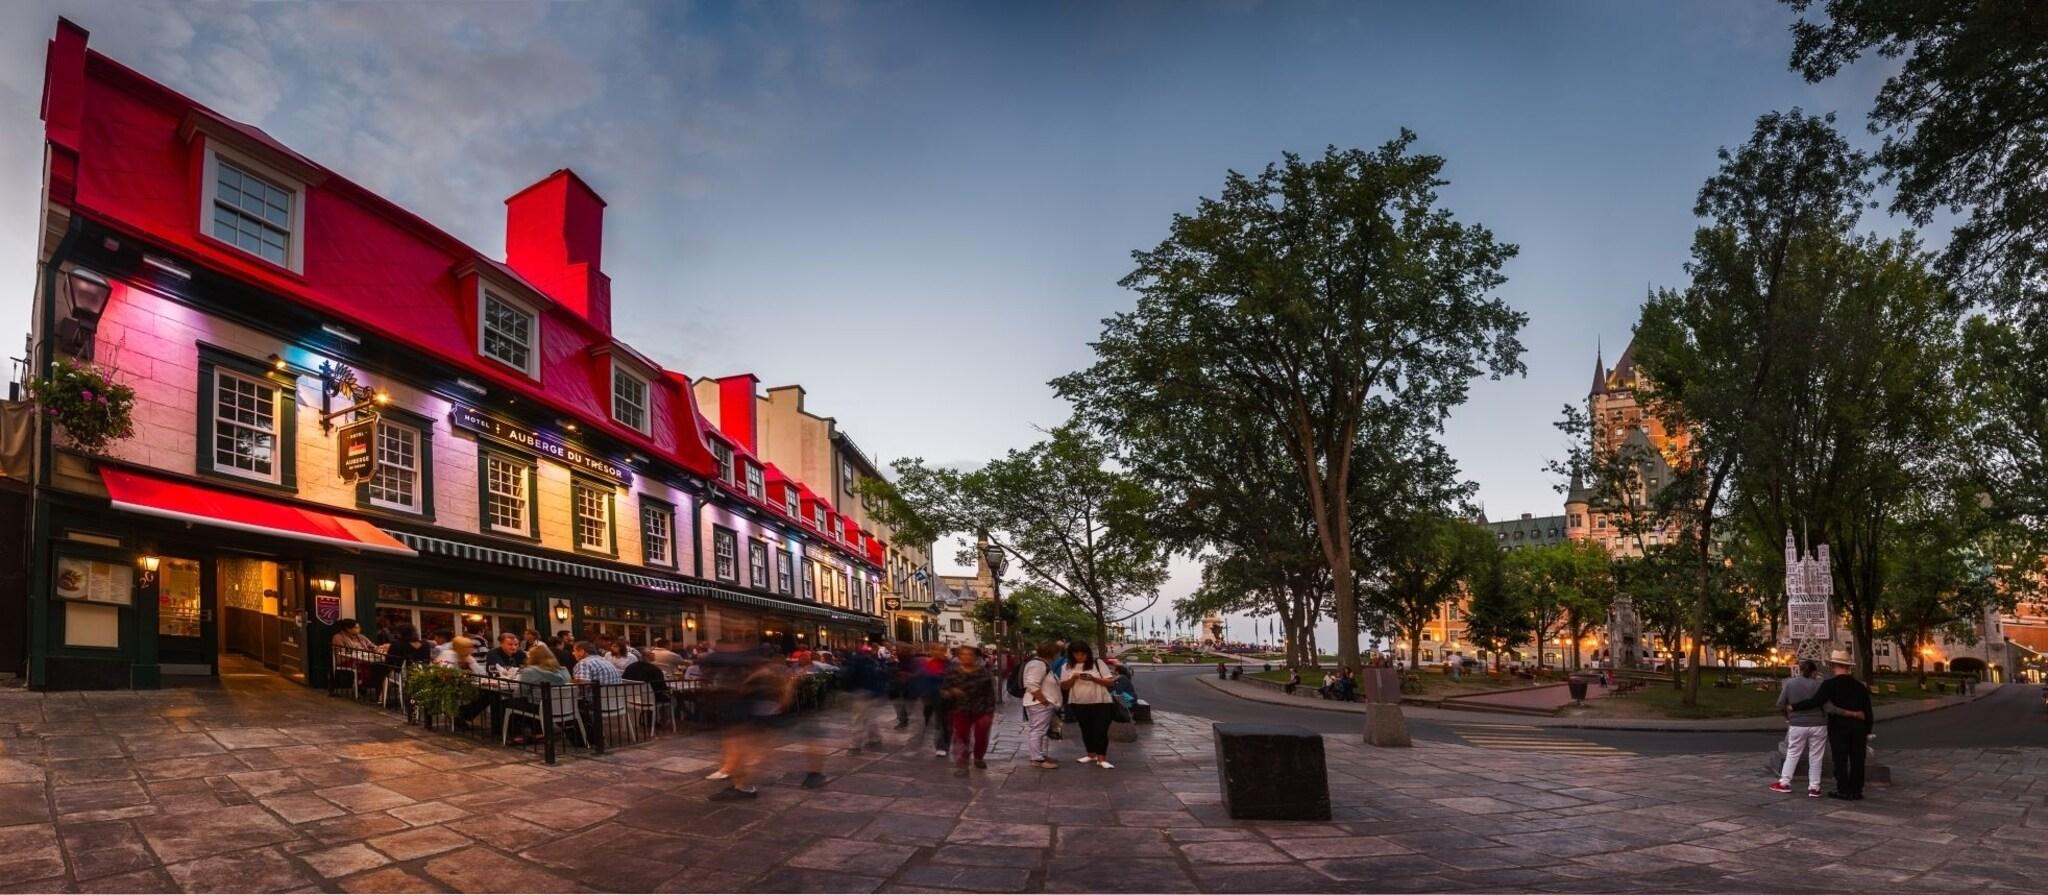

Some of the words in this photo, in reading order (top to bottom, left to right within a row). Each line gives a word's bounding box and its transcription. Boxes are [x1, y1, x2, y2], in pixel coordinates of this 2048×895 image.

[464, 414, 490, 429] HOTEL
[509, 430, 564, 457] AUBERGE
[567, 451, 582, 463] DU
[585, 457, 622, 478] TRÉSOR
